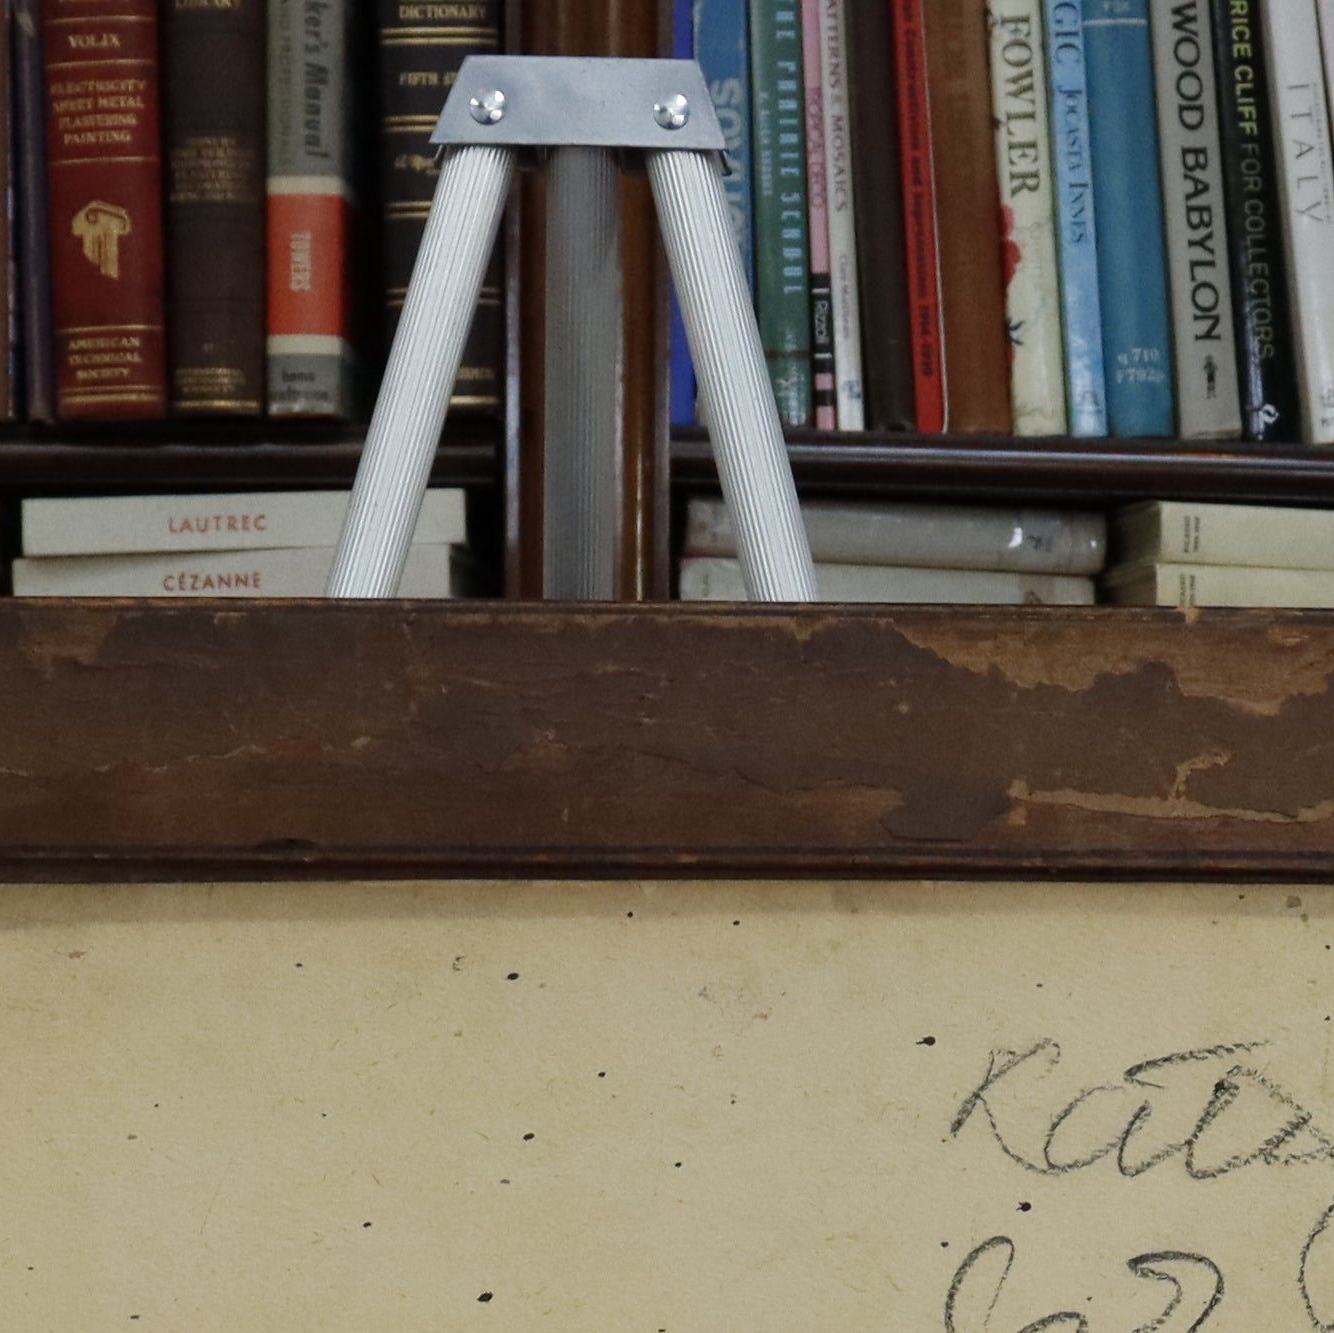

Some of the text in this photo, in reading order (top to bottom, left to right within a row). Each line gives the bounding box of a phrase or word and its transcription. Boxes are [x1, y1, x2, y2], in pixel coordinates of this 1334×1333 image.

[399, 4, 485, 19] DICTIONARY
[50, 79, 146, 96] ELECTRICITY
[52, 95, 145, 113] SHEET METAL
[304, 63, 330, 161] Manual
[1000, 14, 1041, 198] FOWLER
[58, 113, 137, 129] PLASTERING
[777, 60, 801, 176] PRAIRIE
[63, 130, 132, 144] PAINTING
[831, 114, 849, 213] MOSAICS
[1286, 83, 1325, 225] ITALY
[1171, 1, 1222, 342] WOOD BABYLON
[1234, 66, 1275, 361] CLIFF FOR COLLECTORS
[780, 192, 804, 297] SCHOOL
[814, 301, 828, 345] Rizzoli
[68, 337, 140, 351] AMERICAN
[69, 353, 142, 366] TECHNICAL
[76, 367, 130, 381] SOCIETY
[167, 513, 268, 534] LAUTREC
[162, 572, 263, 593] CÉZANNE
